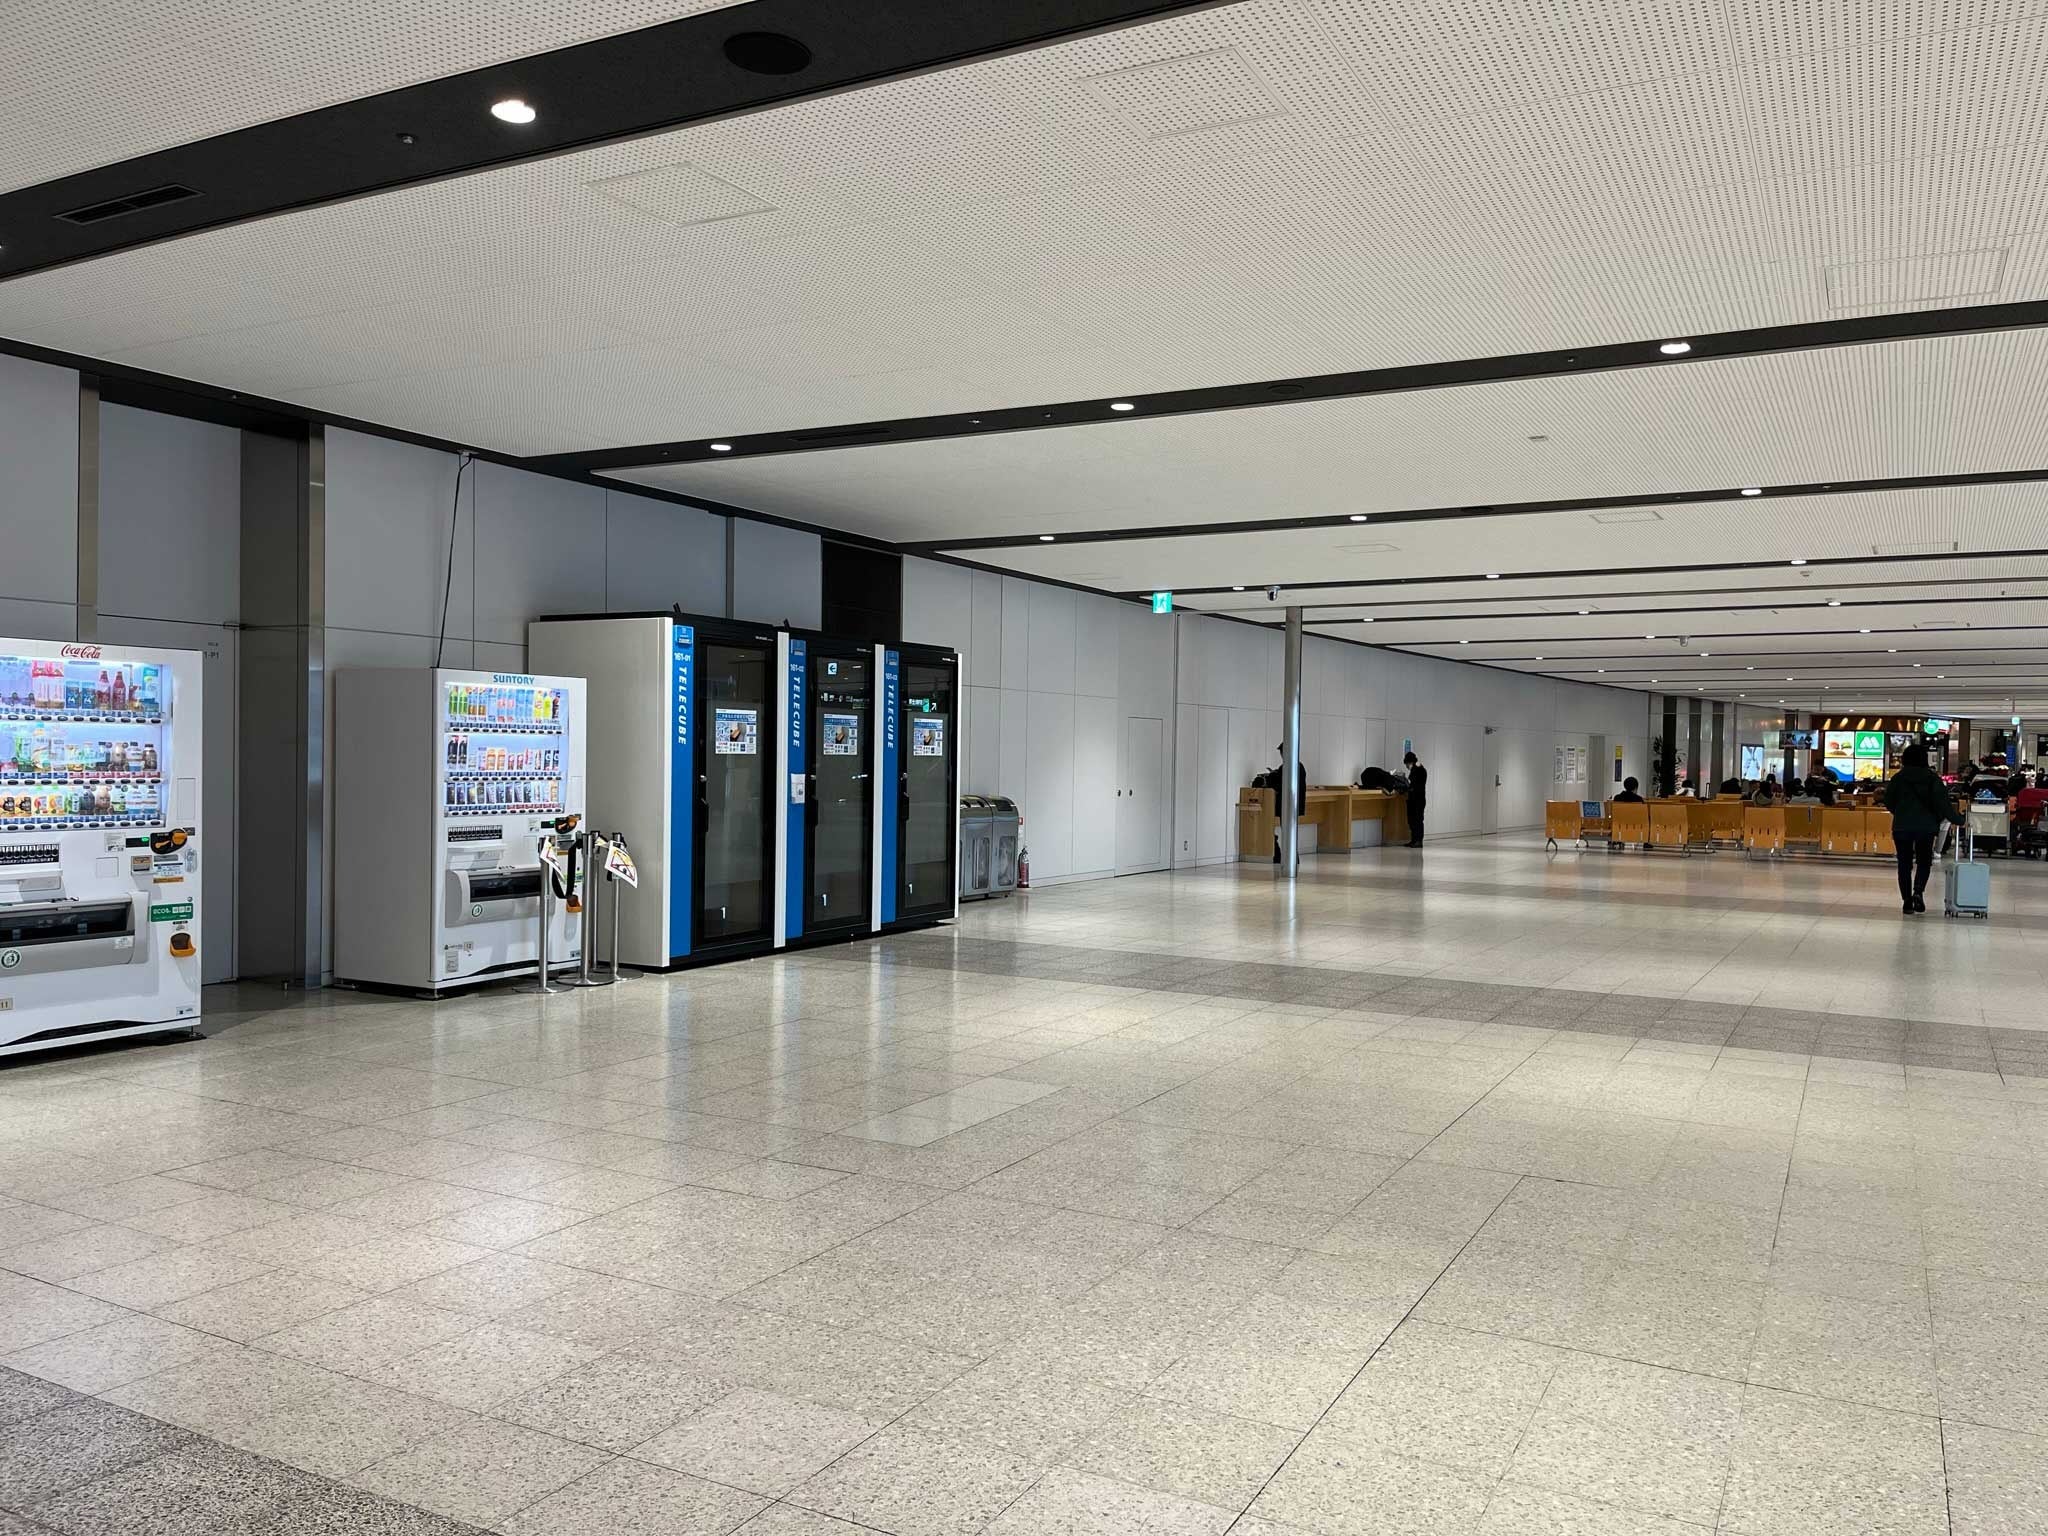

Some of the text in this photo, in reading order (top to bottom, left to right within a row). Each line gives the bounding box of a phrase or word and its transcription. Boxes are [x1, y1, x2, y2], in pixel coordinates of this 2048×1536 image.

[61, 644, 102, 659] Coca-Cola
[493, 674, 535, 685] SUNTORY
[678, 667, 688, 745] TELECUBE
[793, 677, 801, 747] TELECUBE
[887, 684, 895, 749] TELECUBE
